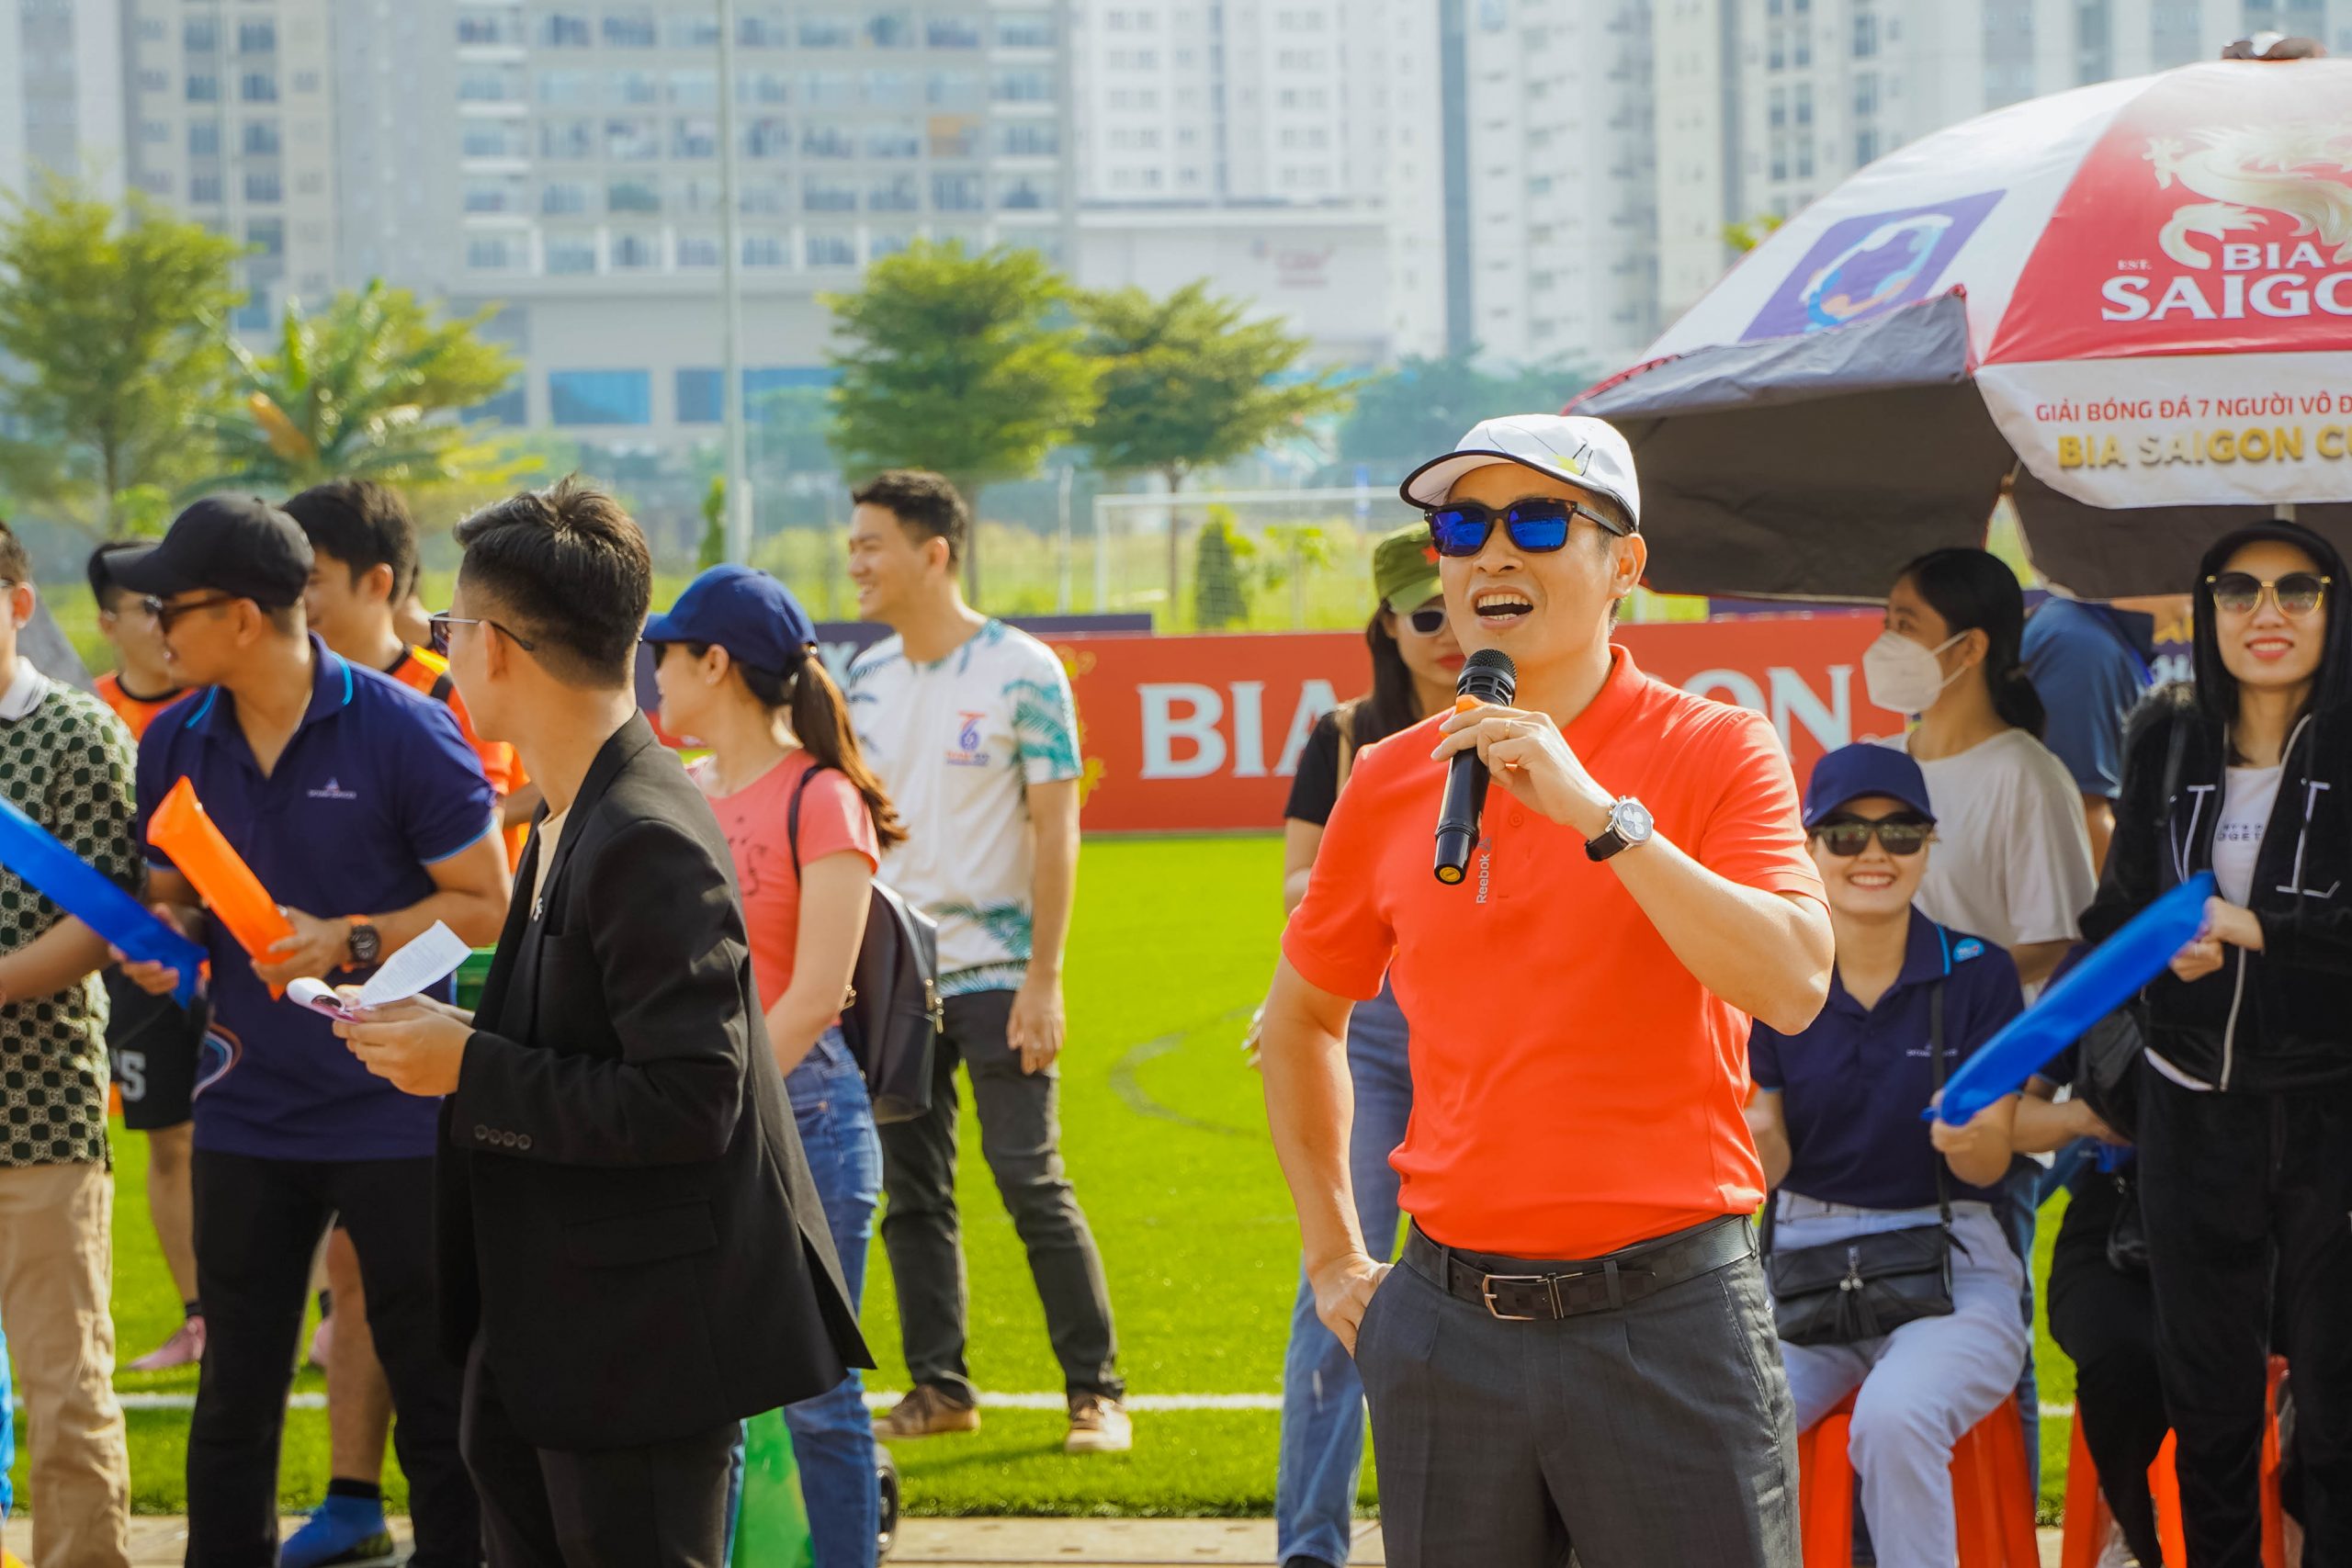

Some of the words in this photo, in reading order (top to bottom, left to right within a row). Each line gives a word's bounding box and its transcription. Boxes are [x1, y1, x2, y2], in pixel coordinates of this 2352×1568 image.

[2222, 242, 2326, 271] BIA
[2036, 398, 2080, 422] GIẢI
[2086, 396, 2154, 422] BÓNG
[2160, 394, 2191, 418] ĐÁ
[2198, 400, 2210, 417] 7
[2217, 390, 2293, 417] NGƯỜI
[2300, 389, 2332, 414] VÔ
[2058, 434, 2128, 469] BIA
[2138, 425, 2303, 467] SAIGON
[2315, 423, 2352, 460] C
[1136, 678, 1340, 780] BIA
[1476, 853, 1491, 904] Reebok
